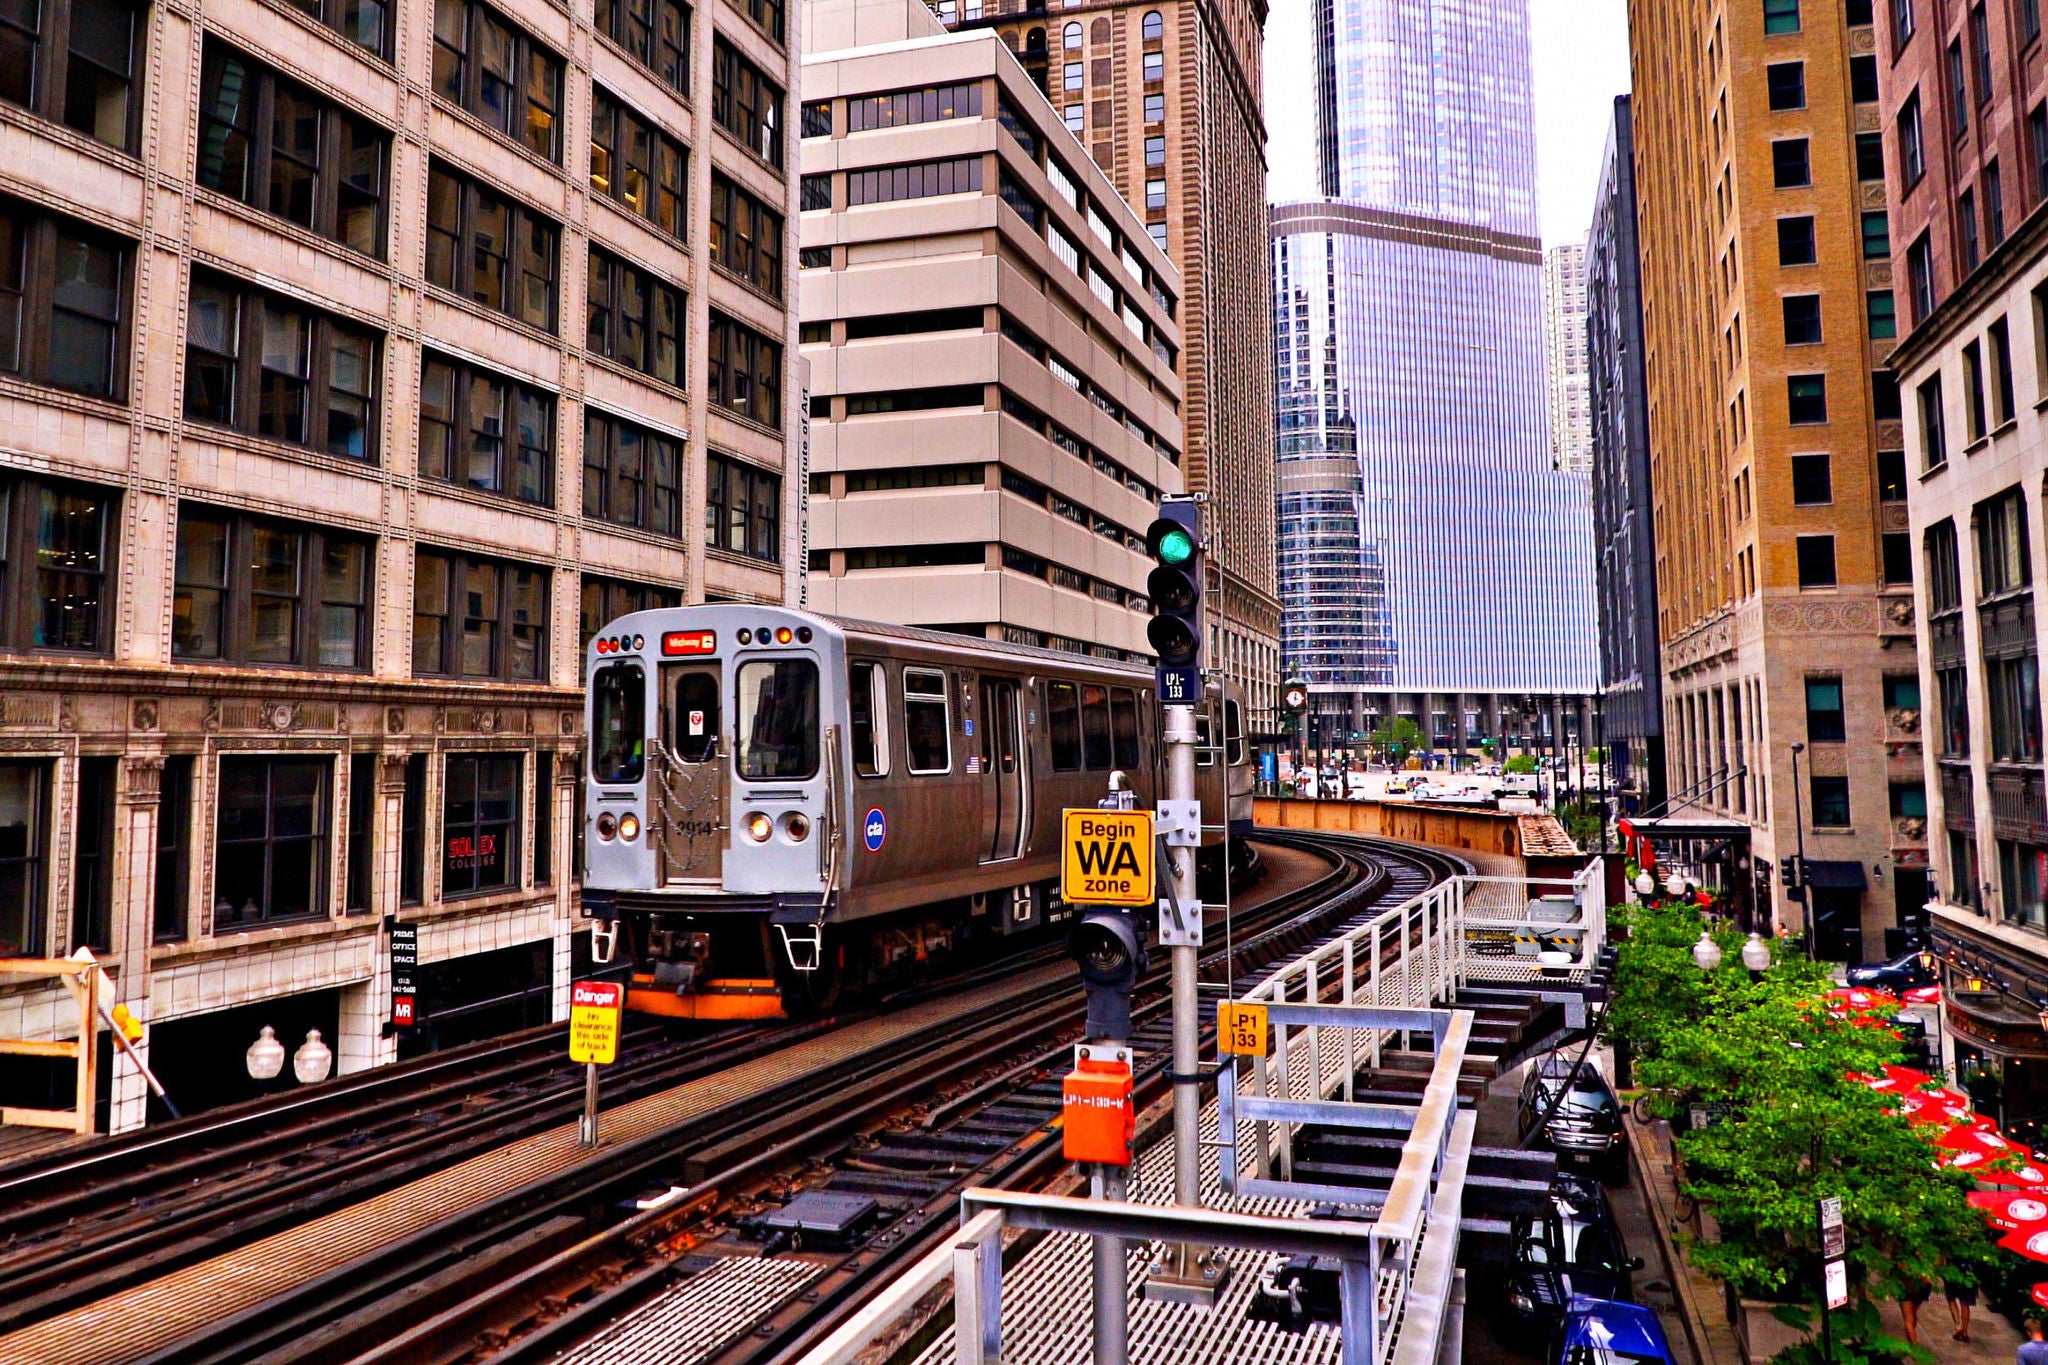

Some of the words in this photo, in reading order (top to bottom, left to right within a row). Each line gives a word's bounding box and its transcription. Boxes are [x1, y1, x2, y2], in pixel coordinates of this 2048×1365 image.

[801, 417, 808, 436] of
[799, 519, 807, 579] Illinois
[799, 585, 807, 610] he
[1166, 673, 1185, 686] LP1-
[1169, 685, 1183, 698] 133
[867, 821, 883, 837] cta
[1081, 820, 1135, 841] Begin
[448, 835, 496, 858] SOLEX
[1074, 840, 1141, 877] WA
[1084, 880, 1131, 893] zone
[393, 930, 415, 938] PRIME
[392, 943, 416, 951] OFFICE
[575, 988, 615, 1005] Danger
[395, 1004, 411, 1018] MR
[573, 1021, 613, 1031] clearance
[593, 1032, 609, 1041] side
[587, 1042, 607, 1051] track
